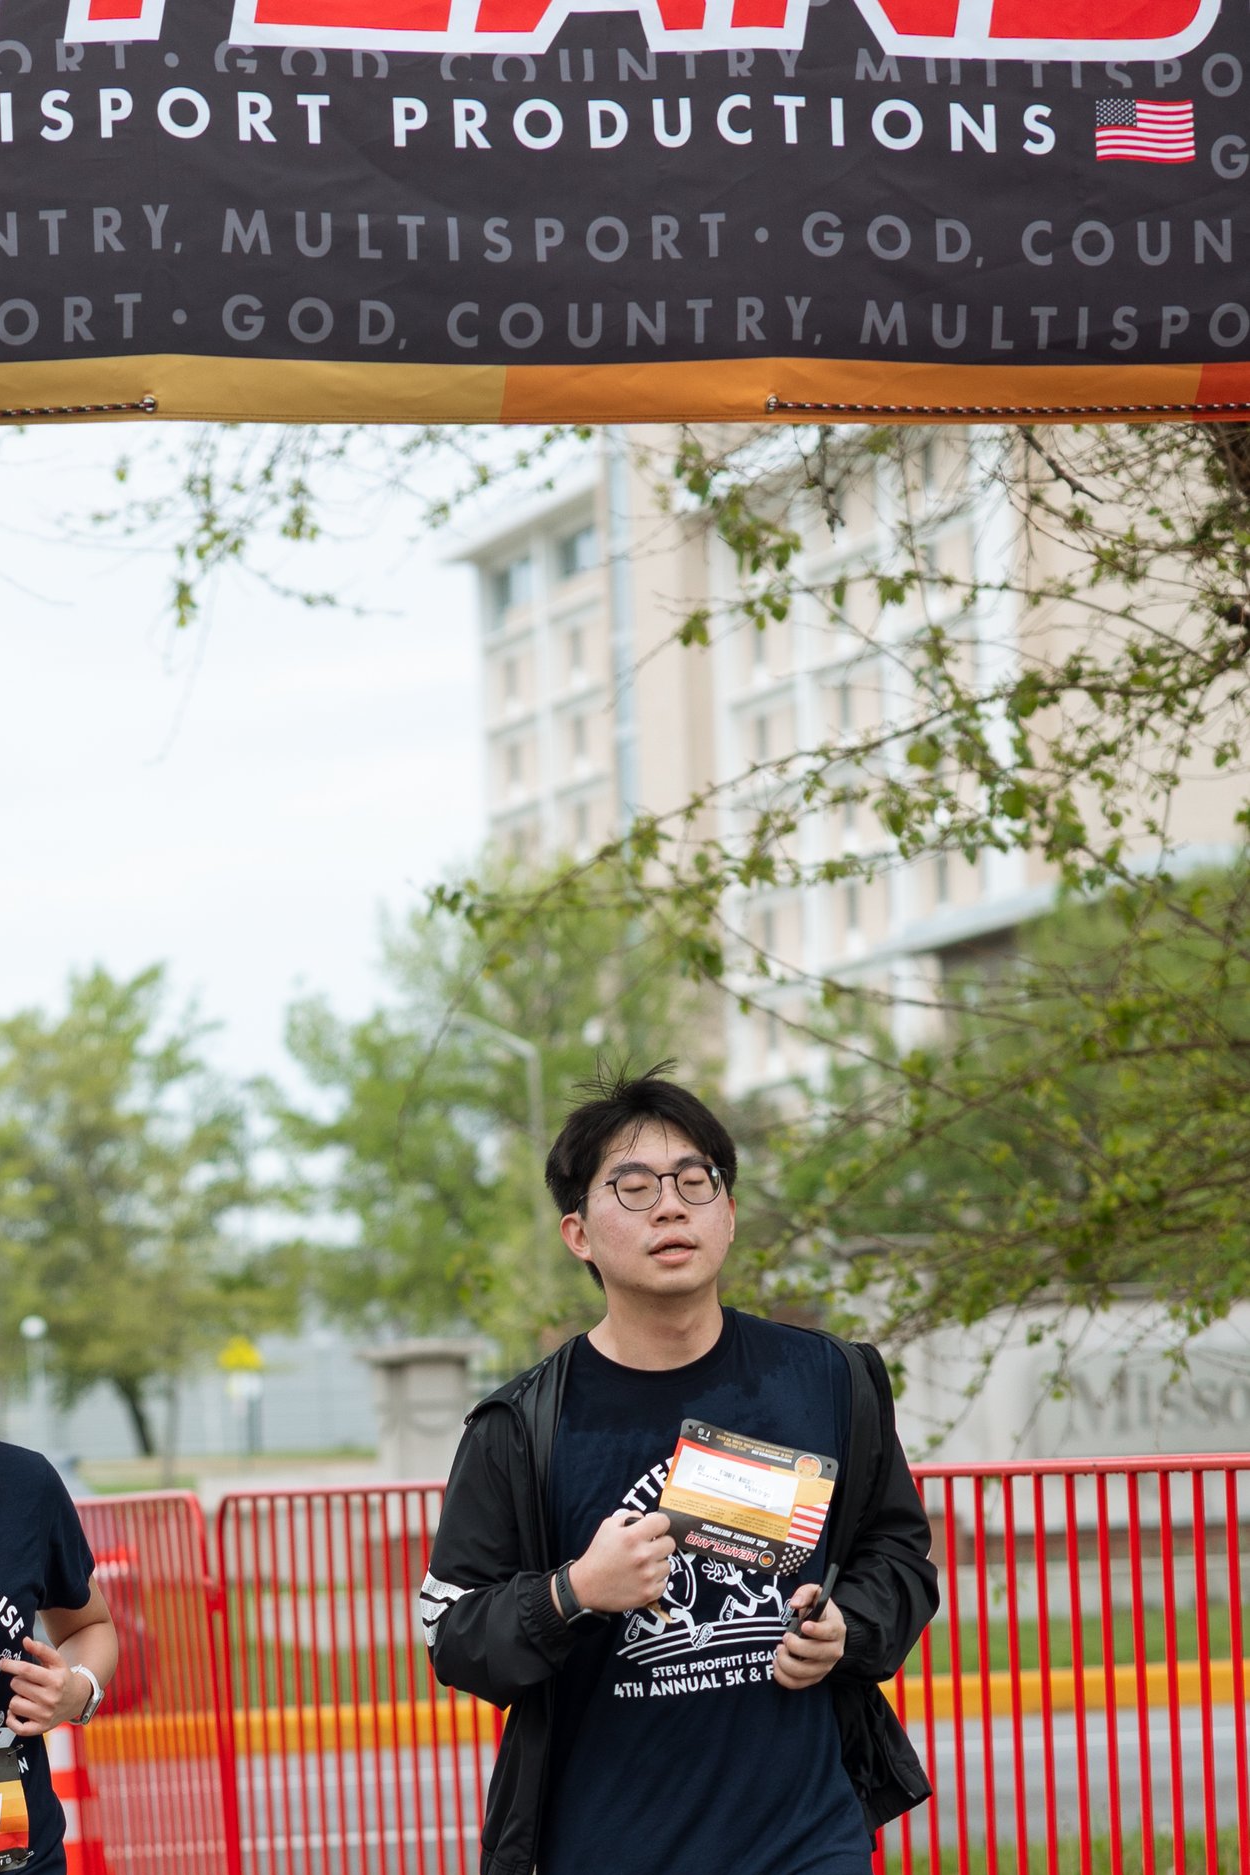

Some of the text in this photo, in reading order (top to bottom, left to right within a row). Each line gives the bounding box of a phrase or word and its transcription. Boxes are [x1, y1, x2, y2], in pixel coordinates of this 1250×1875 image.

[393, 94, 1056, 154] PRODUCTIONS
[222, 208, 726, 262] MULTISPORT
[802, 211, 984, 267] GOD,
[222, 294, 406, 349] GOD,
[447, 296, 822, 348] COUNTRY,
[684, 1533, 759, 1563] HEARTLAND
[614, 1682, 644, 1698] 4TH
[649, 1673, 721, 1697] ANNUAL
[725, 1668, 746, 1687] 5K
[749, 1667, 762, 1682] &
[652, 1663, 687, 1678] STEVE
[689, 1654, 743, 1673] PROFFITT
